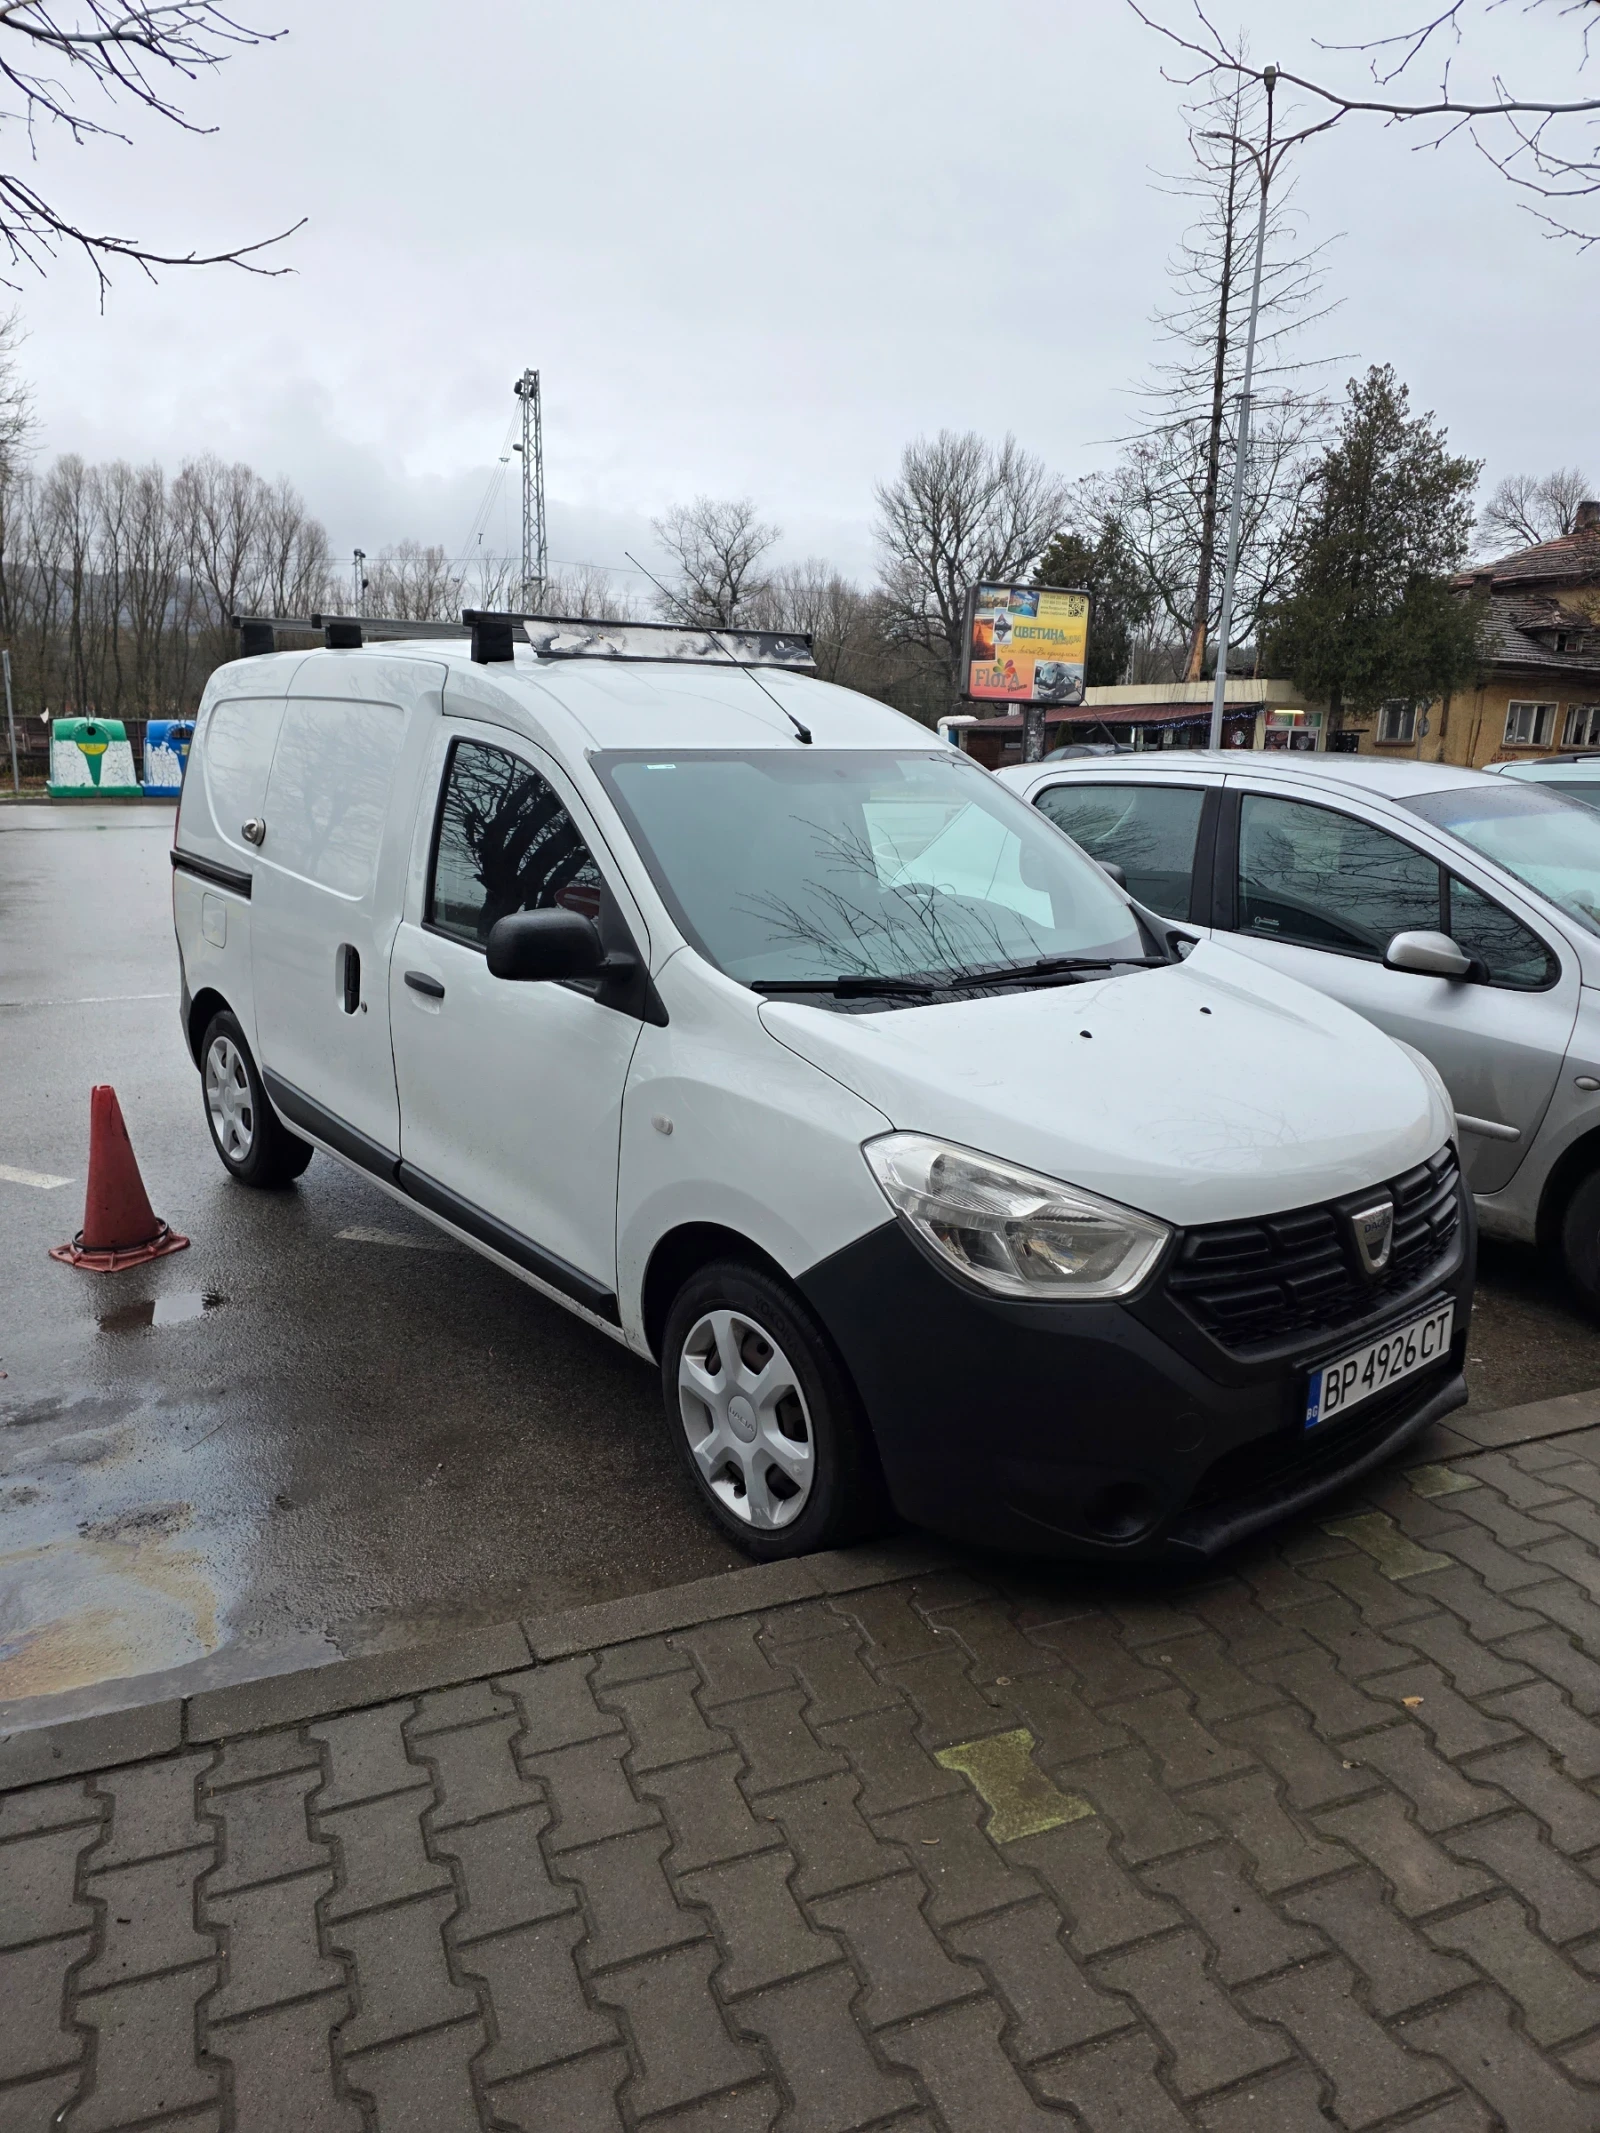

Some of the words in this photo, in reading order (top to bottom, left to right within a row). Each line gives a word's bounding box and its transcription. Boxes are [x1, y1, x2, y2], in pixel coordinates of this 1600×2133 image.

[1014, 626, 1065, 640] ЦВЕТИНА
[1324, 1360, 1358, 1413] BP
[1361, 1328, 1416, 1390] 4926
[1420, 1310, 1450, 1359] CT
[1306, 1405, 1318, 1420] BG
